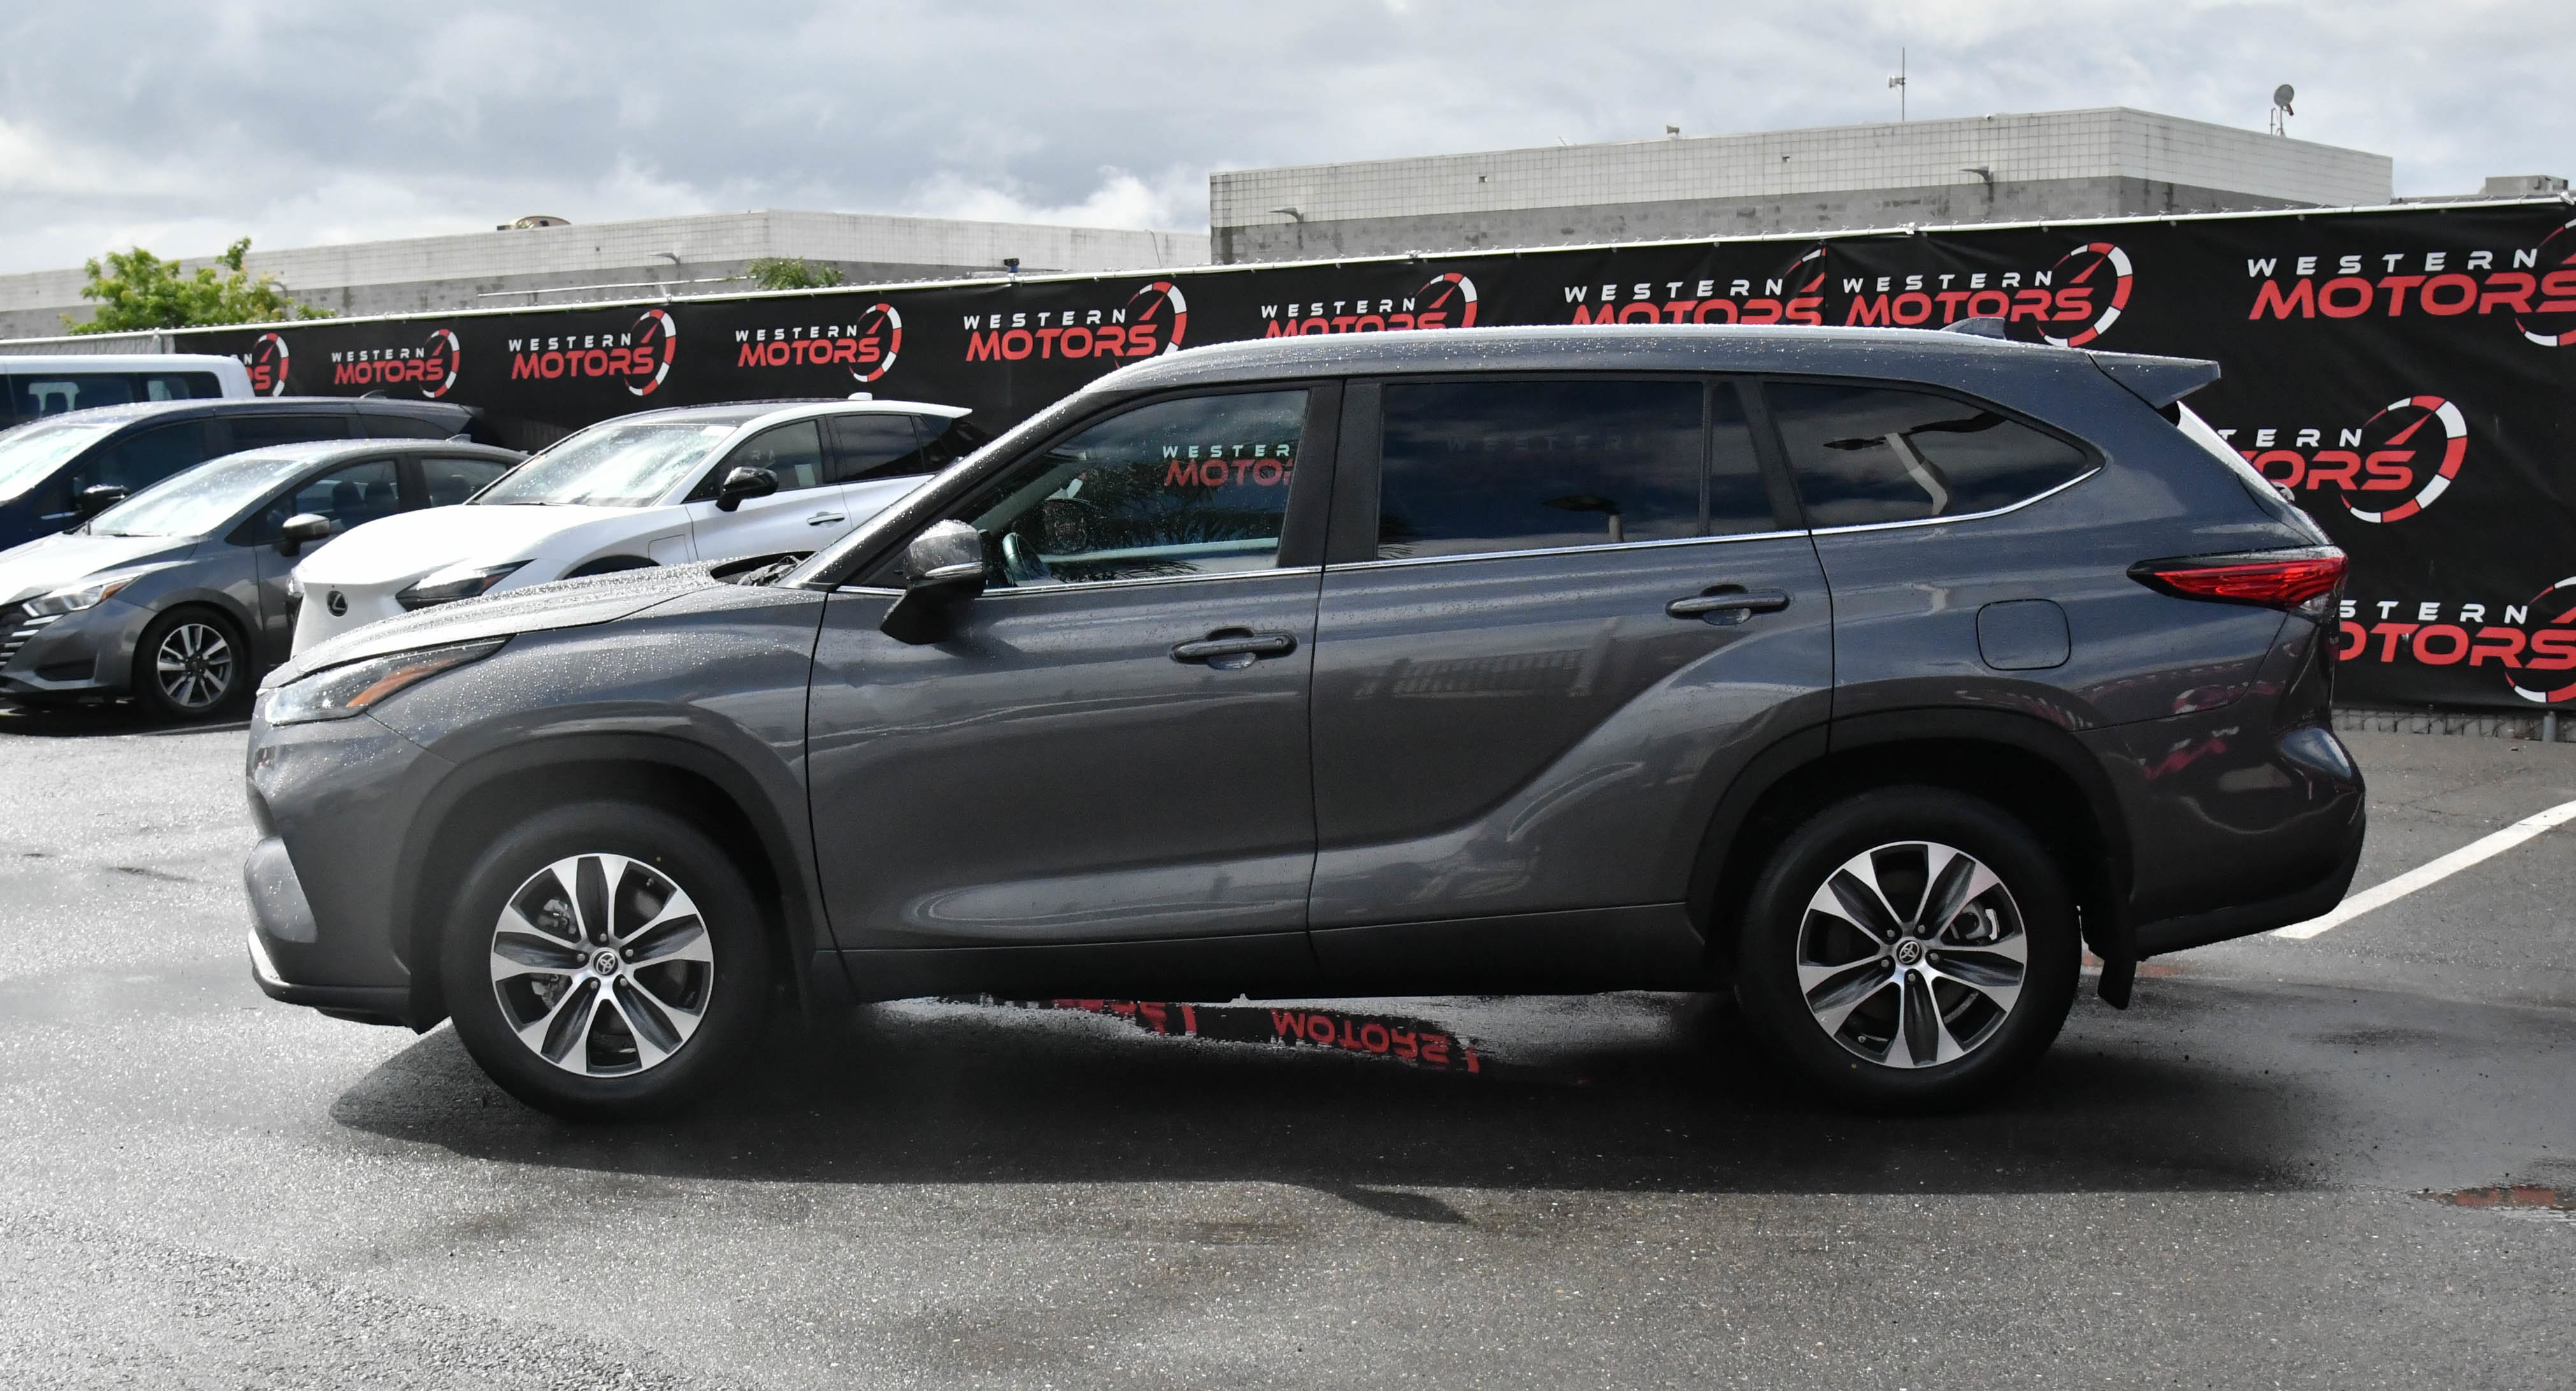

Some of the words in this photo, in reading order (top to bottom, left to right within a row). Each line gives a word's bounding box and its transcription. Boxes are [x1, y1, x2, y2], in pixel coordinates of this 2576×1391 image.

[2247, 248, 2538, 278] WESTERN
[1564, 278, 1783, 303] WESTERN
[1843, 270, 2052, 293] WESTERN
[2249, 269, 2576, 320] MOTORS
[963, 308, 1126, 330] WESTERN
[1261, 297, 1415, 318] WESTERN
[1572, 296, 1824, 326] MOTORS
[1845, 287, 2094, 326] MOTORS
[508, 333, 631, 352] WESTERN
[735, 325, 857, 342] WESTERN
[965, 324, 1157, 361] MOTORS
[331, 347, 425, 363] WESTERN
[511, 346, 655, 380] MOTORS
[738, 337, 881, 367] MOTORS
[334, 358, 444, 385] MOTORS
[2237, 449, 2417, 491] ORS
